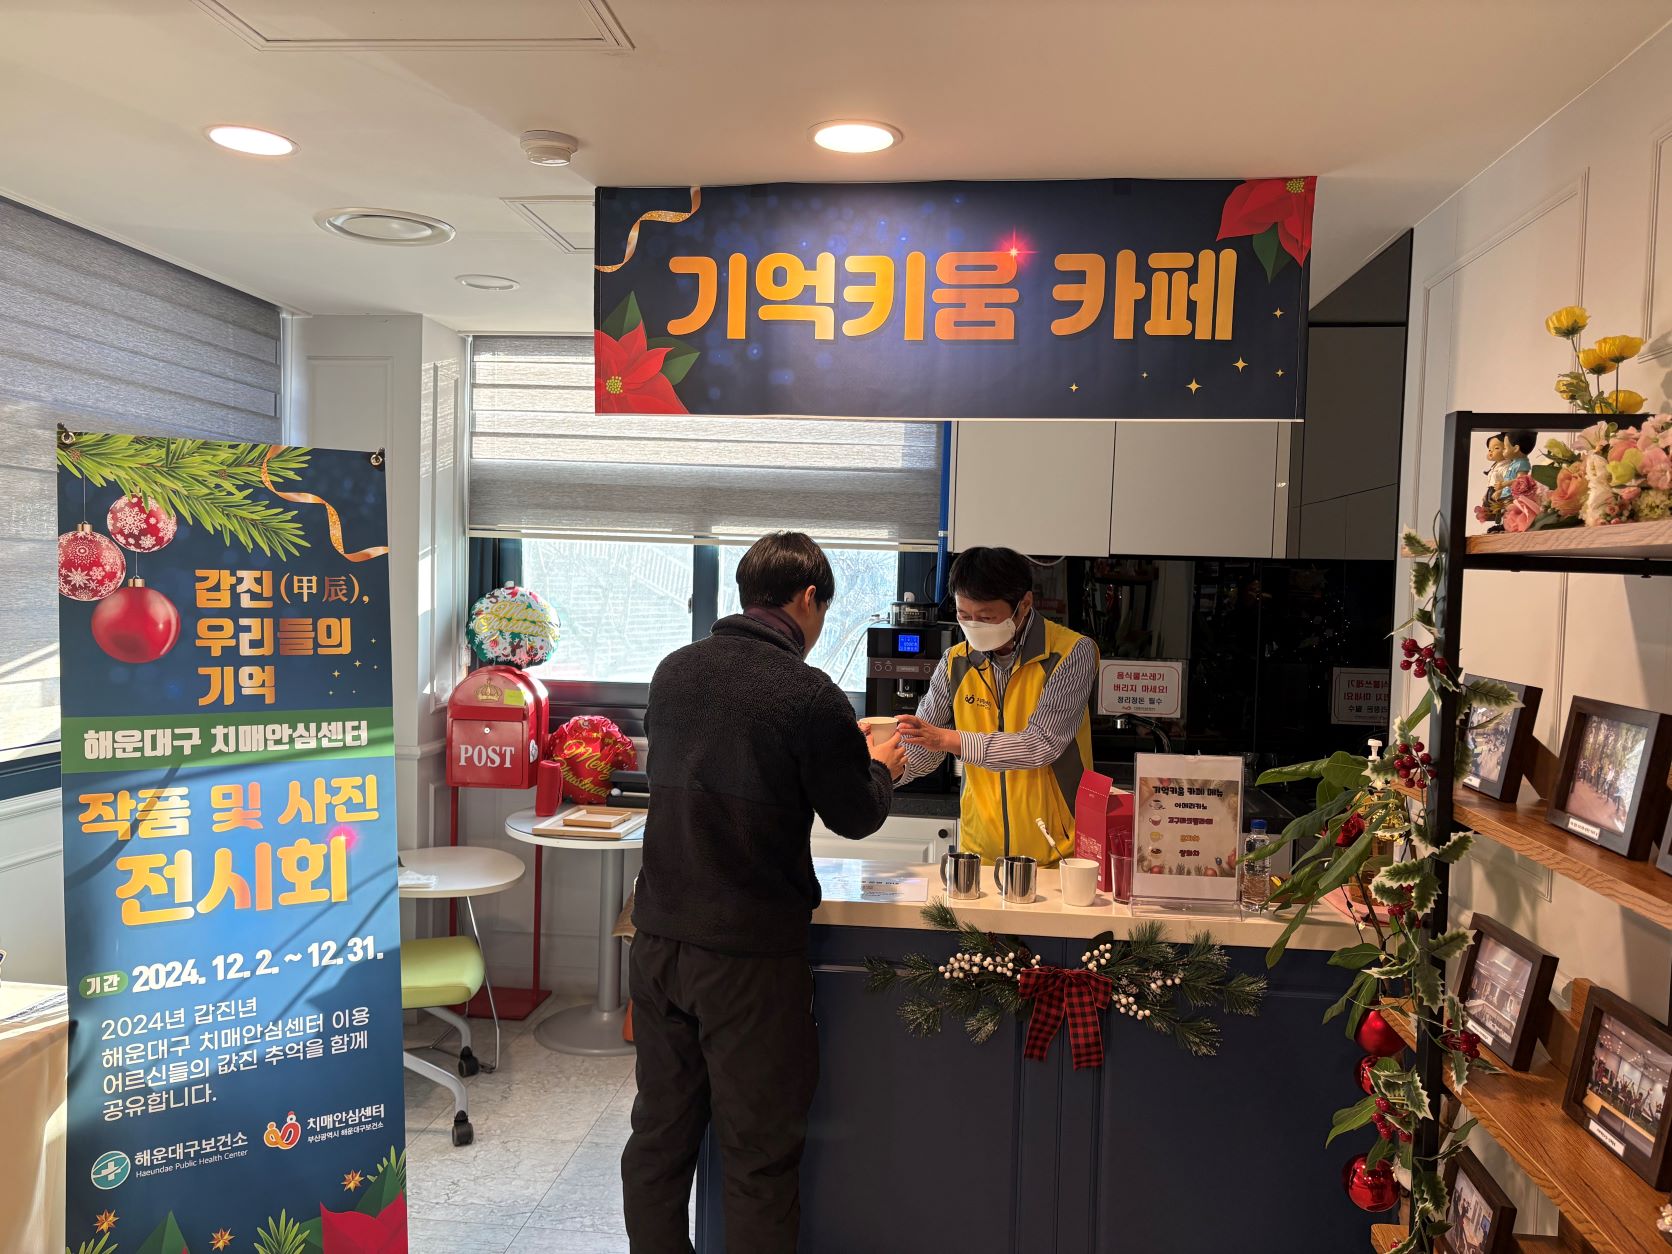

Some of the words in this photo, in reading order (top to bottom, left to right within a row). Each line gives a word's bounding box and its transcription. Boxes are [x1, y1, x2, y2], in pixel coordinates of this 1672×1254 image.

[667, 250, 1019, 341] 기억키움
[1050, 248, 1238, 340] 카페
[194, 616, 352, 657] 우리들의
[197, 665, 276, 706] 기억
[1113, 683, 1137, 693] 버리지
[1141, 685, 1168, 694] 마세요!
[1116, 671, 1165, 682] 음식물쓰레기
[1117, 695, 1145, 705] 정리정돈
[1148, 697, 1163, 706] 필수
[83, 727, 202, 760] 해운대구
[210, 720, 368, 754] 치매안심센터
[458, 744, 515, 768] POST
[561, 739, 616, 780] Merry
[77, 786, 192, 841] 작품
[210, 781, 264, 834] 및
[277, 773, 380, 827] 사진
[114, 834, 350, 927] 전시회
[86, 973, 121, 996] 기간
[131, 957, 207, 993] 2024.
[101, 1007, 185, 1041] 2024년
[193, 996, 257, 1025] 갑진년
[101, 1035, 191, 1069] 해운대구
[200, 1013, 323, 1052] 치매안심센터
[332, 1006, 370, 1029] 이용
[103, 1057, 210, 1095] 어르신들의
[217, 1049, 258, 1075] 값진
[264, 1038, 325, 1066] 추억을
[330, 1030, 368, 1055] 함께
[102, 1083, 217, 1122] 공유합니다.
[306, 1103, 385, 1132] 치매안심센터
[134, 1131, 249, 1167] 해운대구보건소
[307, 1130, 340, 1143] 부산광역시
[340, 1121, 384, 1136] 해운대구보건소
[135, 1165, 174, 1178] Haeundae
[175, 1159, 198, 1170] Public
[198, 1154, 223, 1165] Health
[223, 1149, 249, 1160] Center
